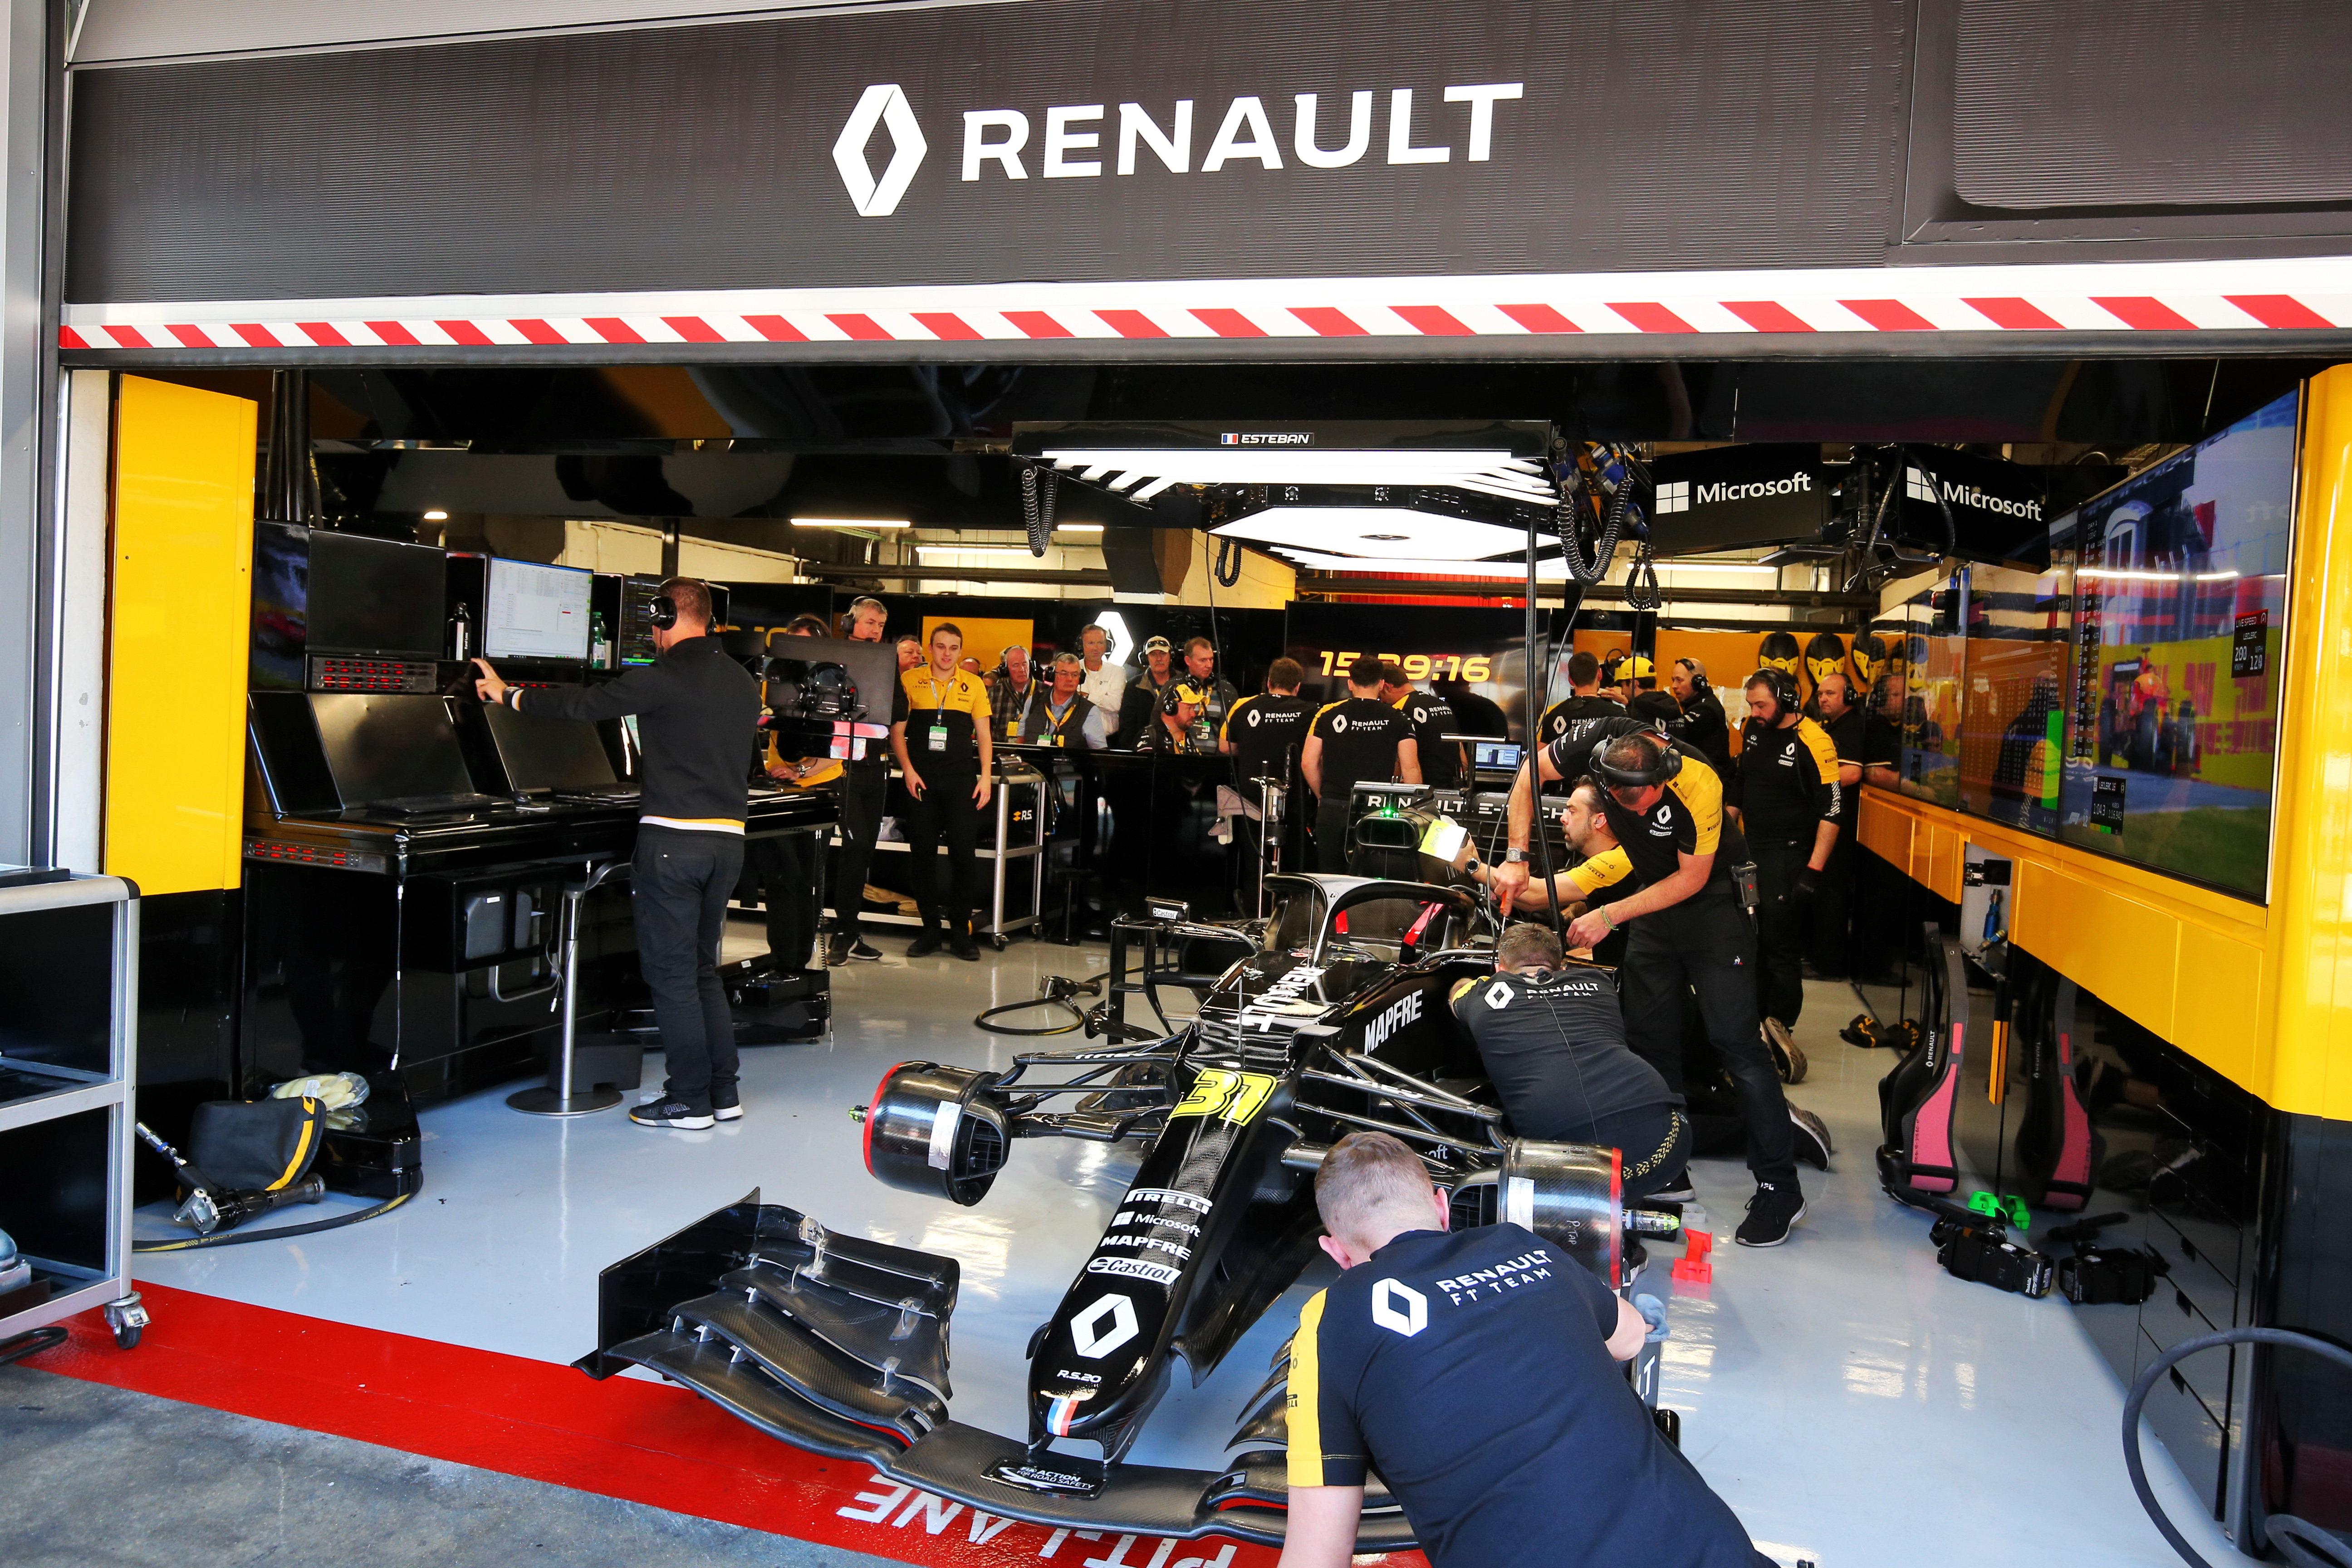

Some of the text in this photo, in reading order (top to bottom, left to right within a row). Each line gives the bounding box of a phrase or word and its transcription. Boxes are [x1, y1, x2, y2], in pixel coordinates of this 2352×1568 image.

[961, 82, 1524, 182] RENAULT
[1240, 433, 1310, 444] ESTEBAN
[1697, 471, 1811, 504] Microsoft
[1943, 481, 2042, 521] Microsoft
[2236, 617, 2257, 627] LIVE SPEED
[2243, 631, 2257, 640] LECLERC
[1320, 651, 1491, 682] 159:16
[2099, 781, 2112, 790] LECLERC
[1367, 795, 1464, 812] RNLT
[1652, 822, 1673, 830] RENAULT
[1156, 910, 1176, 918] Castrol
[1526, 982, 1599, 994] RENAULT
[1364, 989, 1423, 1056] MAPFRE
[1167, 1068, 1279, 1126] 31
[1124, 1188, 1213, 1215] PIRELLI
[1134, 1213, 1200, 1238] Microsoft
[1100, 1235, 1192, 1260] MAPFRE
[1107, 1258, 1175, 1282] Castrol
[1436, 1249, 1552, 1294] RENAULT
[1490, 1268, 1551, 1295] TEAM
[1057, 1369, 1102, 1383] R.S.20
[1030, 1474, 1058, 1483] ROAD
[1057, 1475, 1094, 1490] SAFETY
[1036, 1470, 1081, 1482] ACTION
